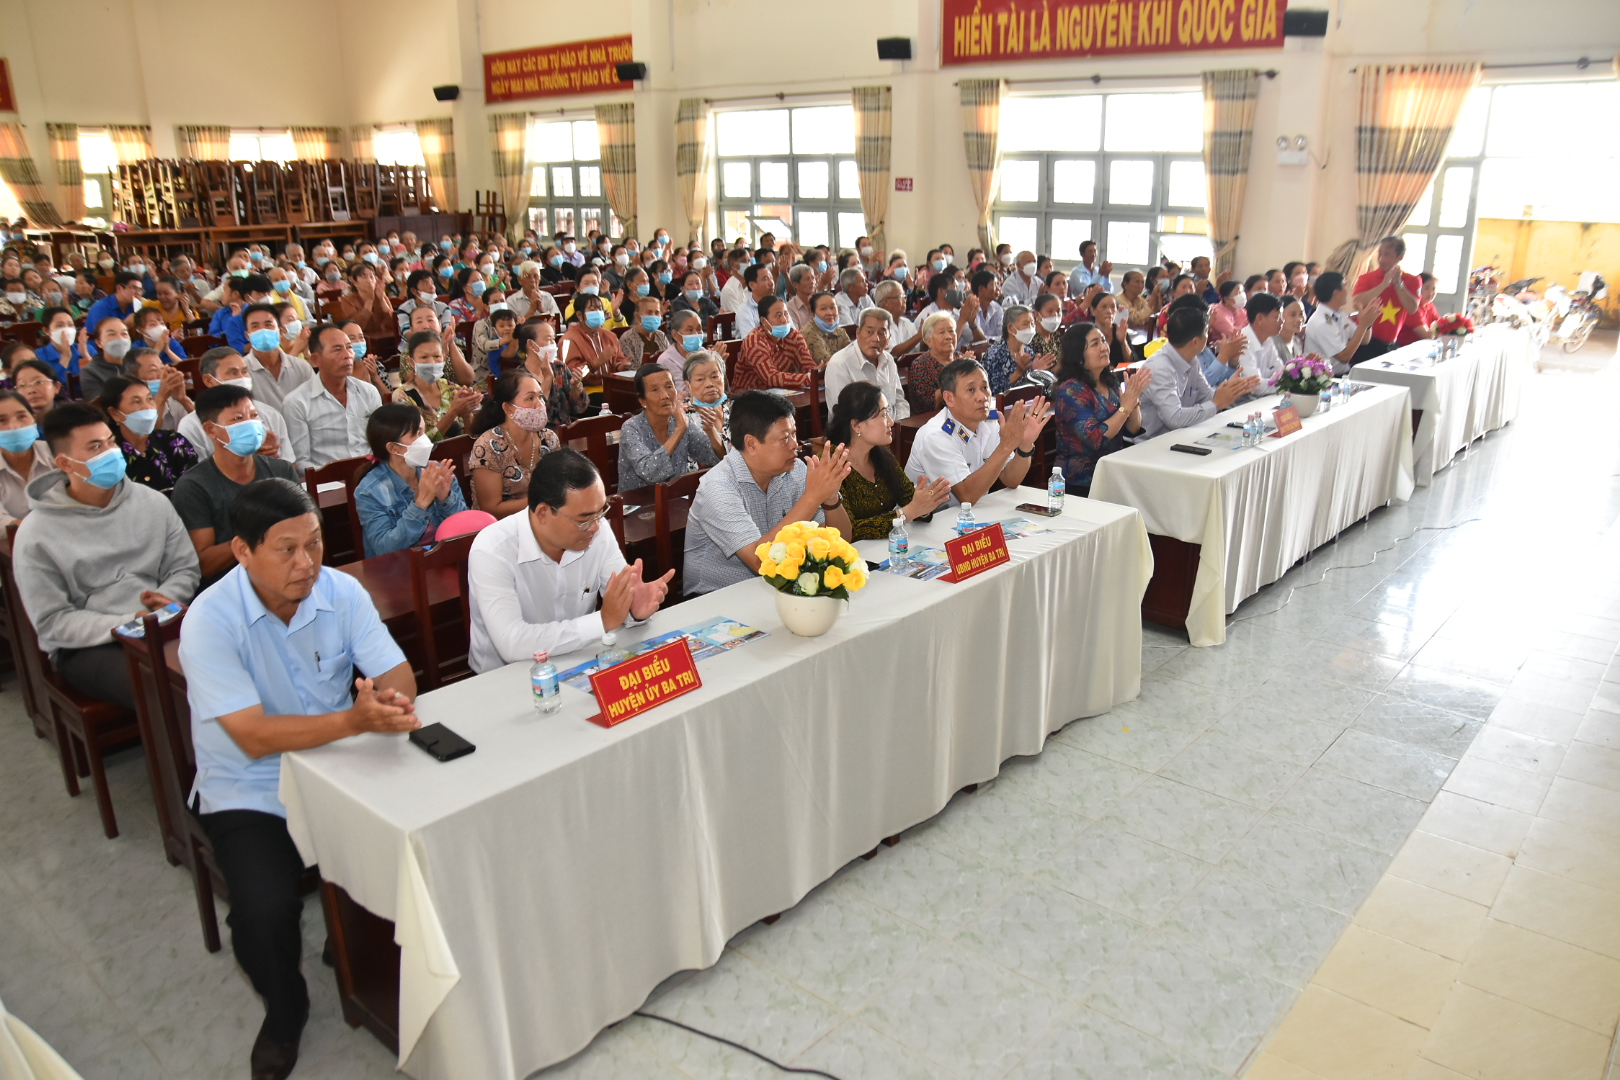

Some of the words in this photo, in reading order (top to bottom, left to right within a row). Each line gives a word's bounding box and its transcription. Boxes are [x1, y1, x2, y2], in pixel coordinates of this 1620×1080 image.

[997, 1, 1025, 54] TÀI
[1030, 0, 1051, 52] LÀ
[1056, 0, 1133, 51] NGUYÊN
[1240, 0, 1277, 42] GIA
[961, 542, 975, 557] ĐẠI
[975, 532, 992, 551] BIỂU
[956, 561, 971, 575] UBND
[619, 670, 642, 690] ĐẠI
[641, 655, 671, 680] BIỂU
[608, 691, 646, 718] HUYỆN
[644, 683, 661, 701] ỦY
[661, 678, 678, 695] BA
[676, 670, 694, 688] TRI
